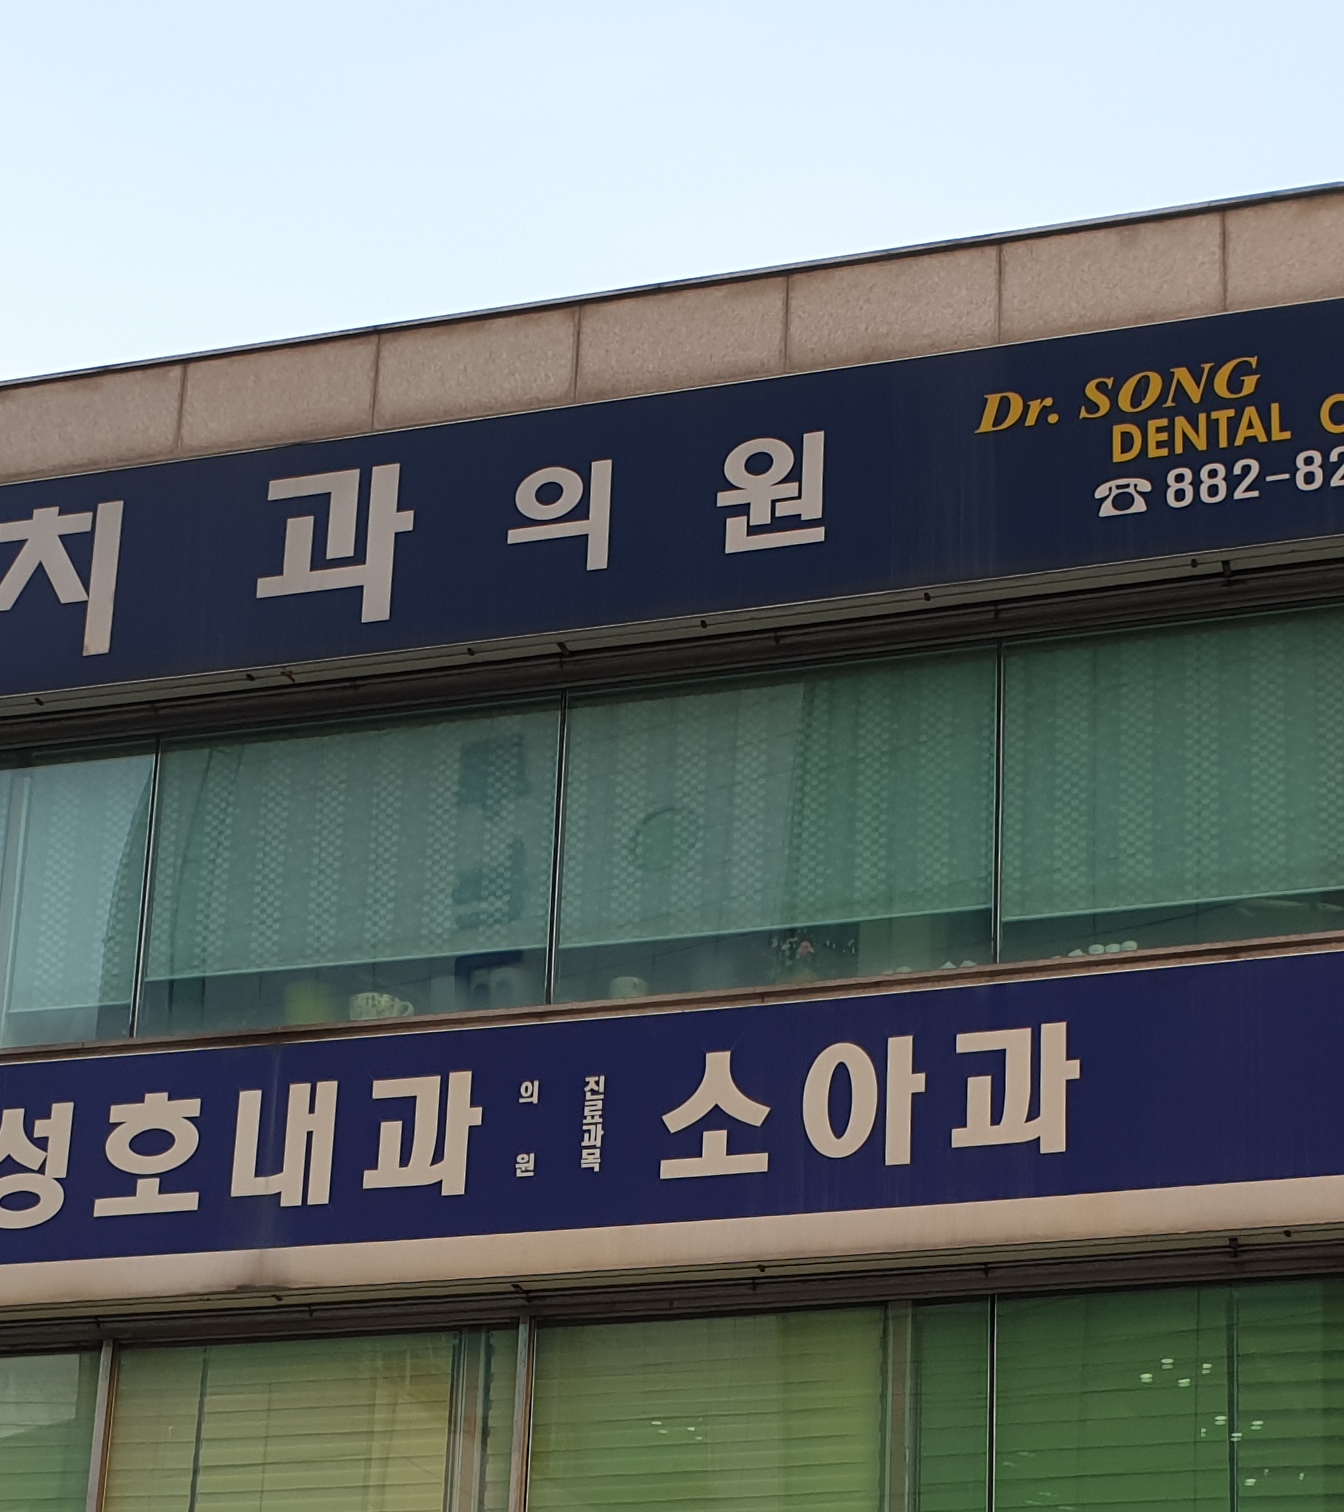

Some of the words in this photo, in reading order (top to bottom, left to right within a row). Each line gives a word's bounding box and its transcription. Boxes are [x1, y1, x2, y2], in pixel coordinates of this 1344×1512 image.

[974, 391, 1060, 433] Dr.
[1079, 356, 1261, 419] SONG
[1111, 403, 1291, 463] DENTAL
[580, 1075, 605, 1172] 진료과목
[660, 1022, 1081, 1180] 소아과
